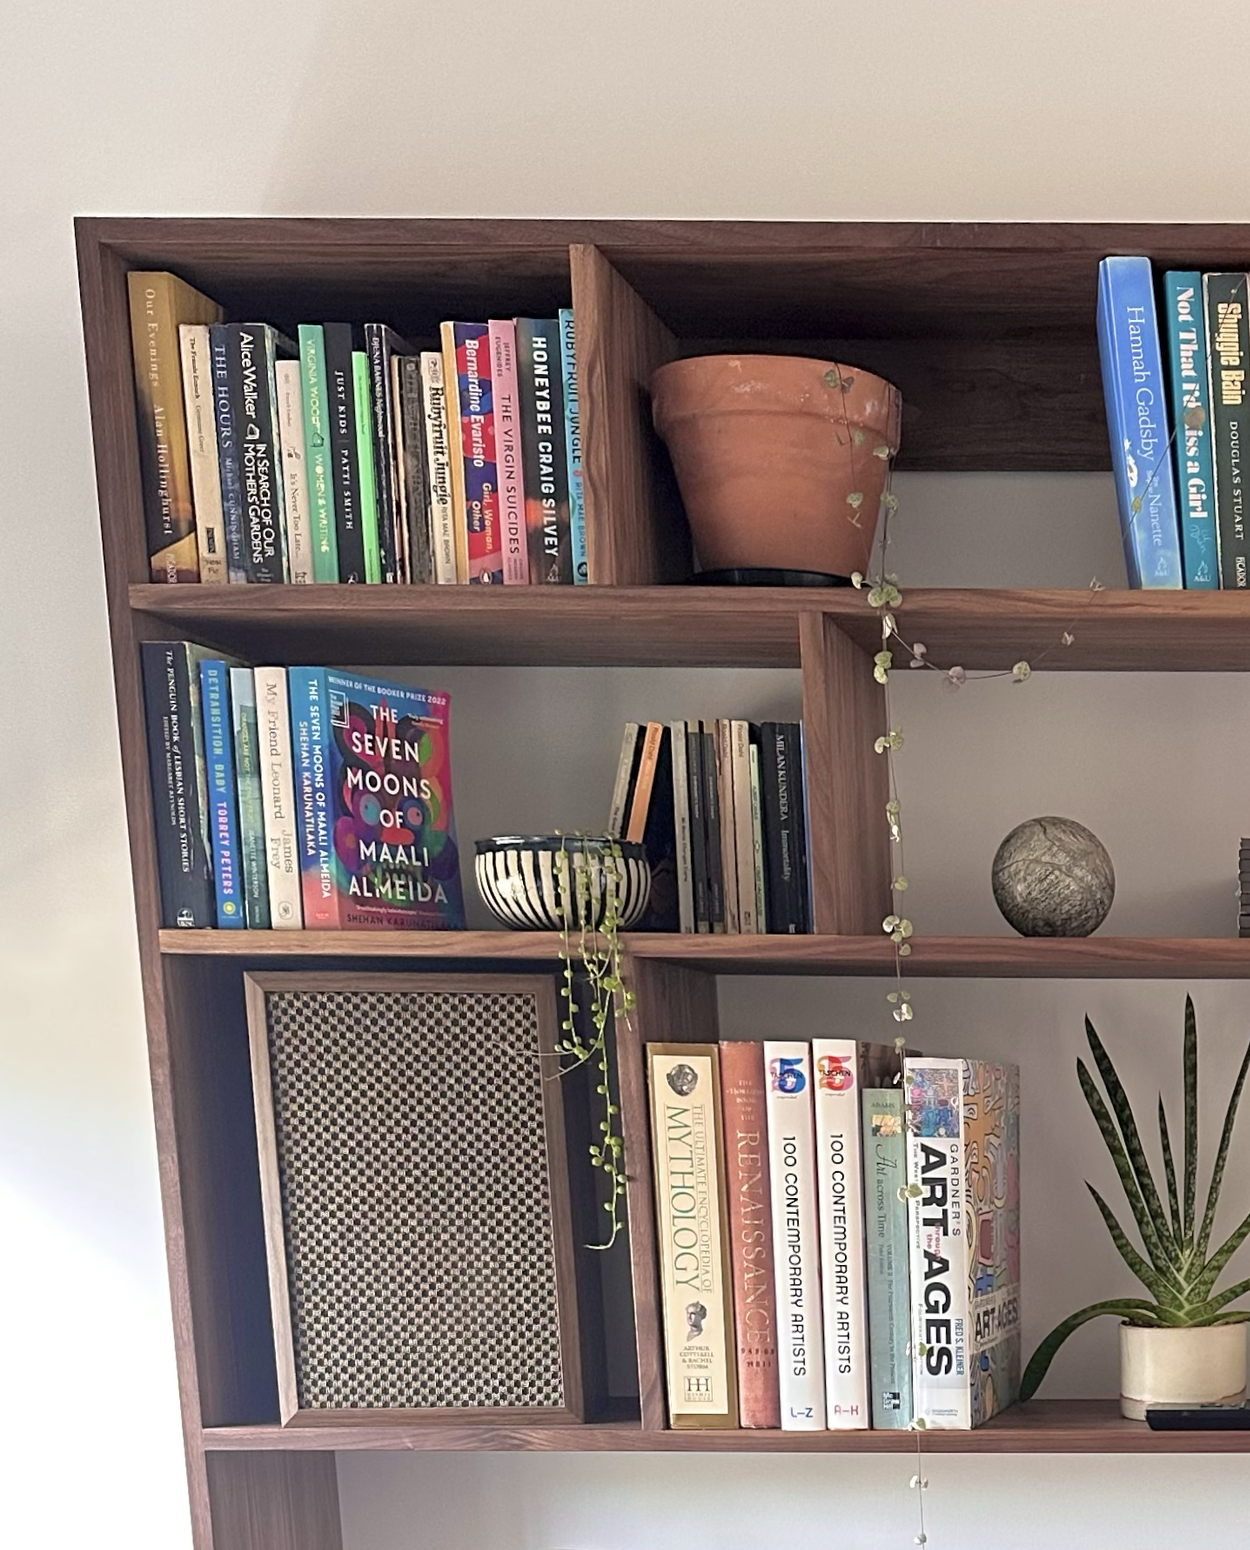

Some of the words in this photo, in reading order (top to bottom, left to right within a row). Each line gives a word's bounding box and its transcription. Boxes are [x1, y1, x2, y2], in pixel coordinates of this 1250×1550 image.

[145, 288, 156, 315] Our
[147, 322, 160, 387] Evenings
[1126, 305, 1152, 384] Hannah
[1215, 302, 1244, 366] Shuggie
[214, 346, 228, 379] THE
[465, 339, 483, 412] Bernardine
[334, 370, 345, 400] JUST
[532, 337, 553, 436] HONEYBEE
[1220, 370, 1246, 406] Bain
[153, 404, 164, 437] Alan
[217, 386, 233, 448] HOURS
[337, 404, 348, 435] KIDS
[501, 394, 513, 422] THE
[1136, 388, 1160, 462] Gadsby
[469, 414, 485, 467] Evaristo
[503, 428, 516, 479] VIRGIN
[1229, 420, 1241, 484] DOUGLAS
[157, 444, 173, 534] Hollinghurst
[341, 449, 351, 485] PATTI
[538, 441, 555, 494] CRAIG
[343, 490, 354, 530] SMITH
[506, 485, 520, 554] SUICIDES
[542, 501, 560, 557] SILVEY
[1148, 493, 1164, 547] Nanette
[1232, 487, 1246, 541] STUART
[167, 667, 178, 711] PENGUIN
[264, 683, 277, 702] My
[308, 679, 318, 702] THE
[328, 675, 354, 688] WINNER
[354, 681, 363, 690] OF
[364, 683, 376, 694] THE
[376, 686, 405, 700] BOOKER
[405, 691, 427, 702] PRIZE
[427, 695, 447, 706] 2022
[170, 714, 180, 742] BOOK
[267, 709, 281, 757] Friend
[309, 705, 321, 740] SEVEN
[370, 704, 399, 724] THE
[299, 721, 310, 767] SHEHAN
[313, 744, 325, 788] MOONS
[351, 731, 420, 763] SEVEN
[775, 734, 787, 770] MILAN
[173, 755, 184, 795] LESBIAN
[270, 762, 285, 820] Leonard
[346, 766, 432, 799] MOONS
[777, 771, 790, 822] KUNDERA
[176, 797, 187, 830] SHORT
[302, 771, 317, 856] KARUNATILAKA
[315, 791, 326, 807] OF
[379, 809, 404, 829] OF
[217, 801, 230, 847] TORREY
[316, 811, 328, 846] MAALI
[179, 832, 190, 873] STORIES
[221, 850, 234, 895] PETERS
[271, 836, 281, 869] Frey
[282, 829, 293, 874] James
[359, 839, 429, 867] MAALI
[319, 850, 332, 899] ALMEIDA
[349, 875, 449, 904] ALMEIDA
[782, 1136, 797, 1167] 100
[829, 1133, 844, 1165] 100
[876, 1143, 898, 1177] Art
[666, 1105, 701, 1293] MYTHOLOGY
[876, 1178, 886, 1214] across
[920, 1142, 949, 1237] ART
[949, 1143, 962, 1237] GARDNER'S
[736, 1130, 771, 1343] RENAISSANCE
[784, 1172, 804, 1308] CONTEMPORARY
[831, 1170, 849, 1306] CONTEMPORARY
[877, 1214, 888, 1239] Time
[922, 1249, 954, 1377] AGES
[953, 1318, 964, 1336] FRED
[792, 1313, 806, 1377] ARTISTS
[836, 1311, 852, 1374] ARTISTS
[955, 1346, 966, 1376] KLEINER
